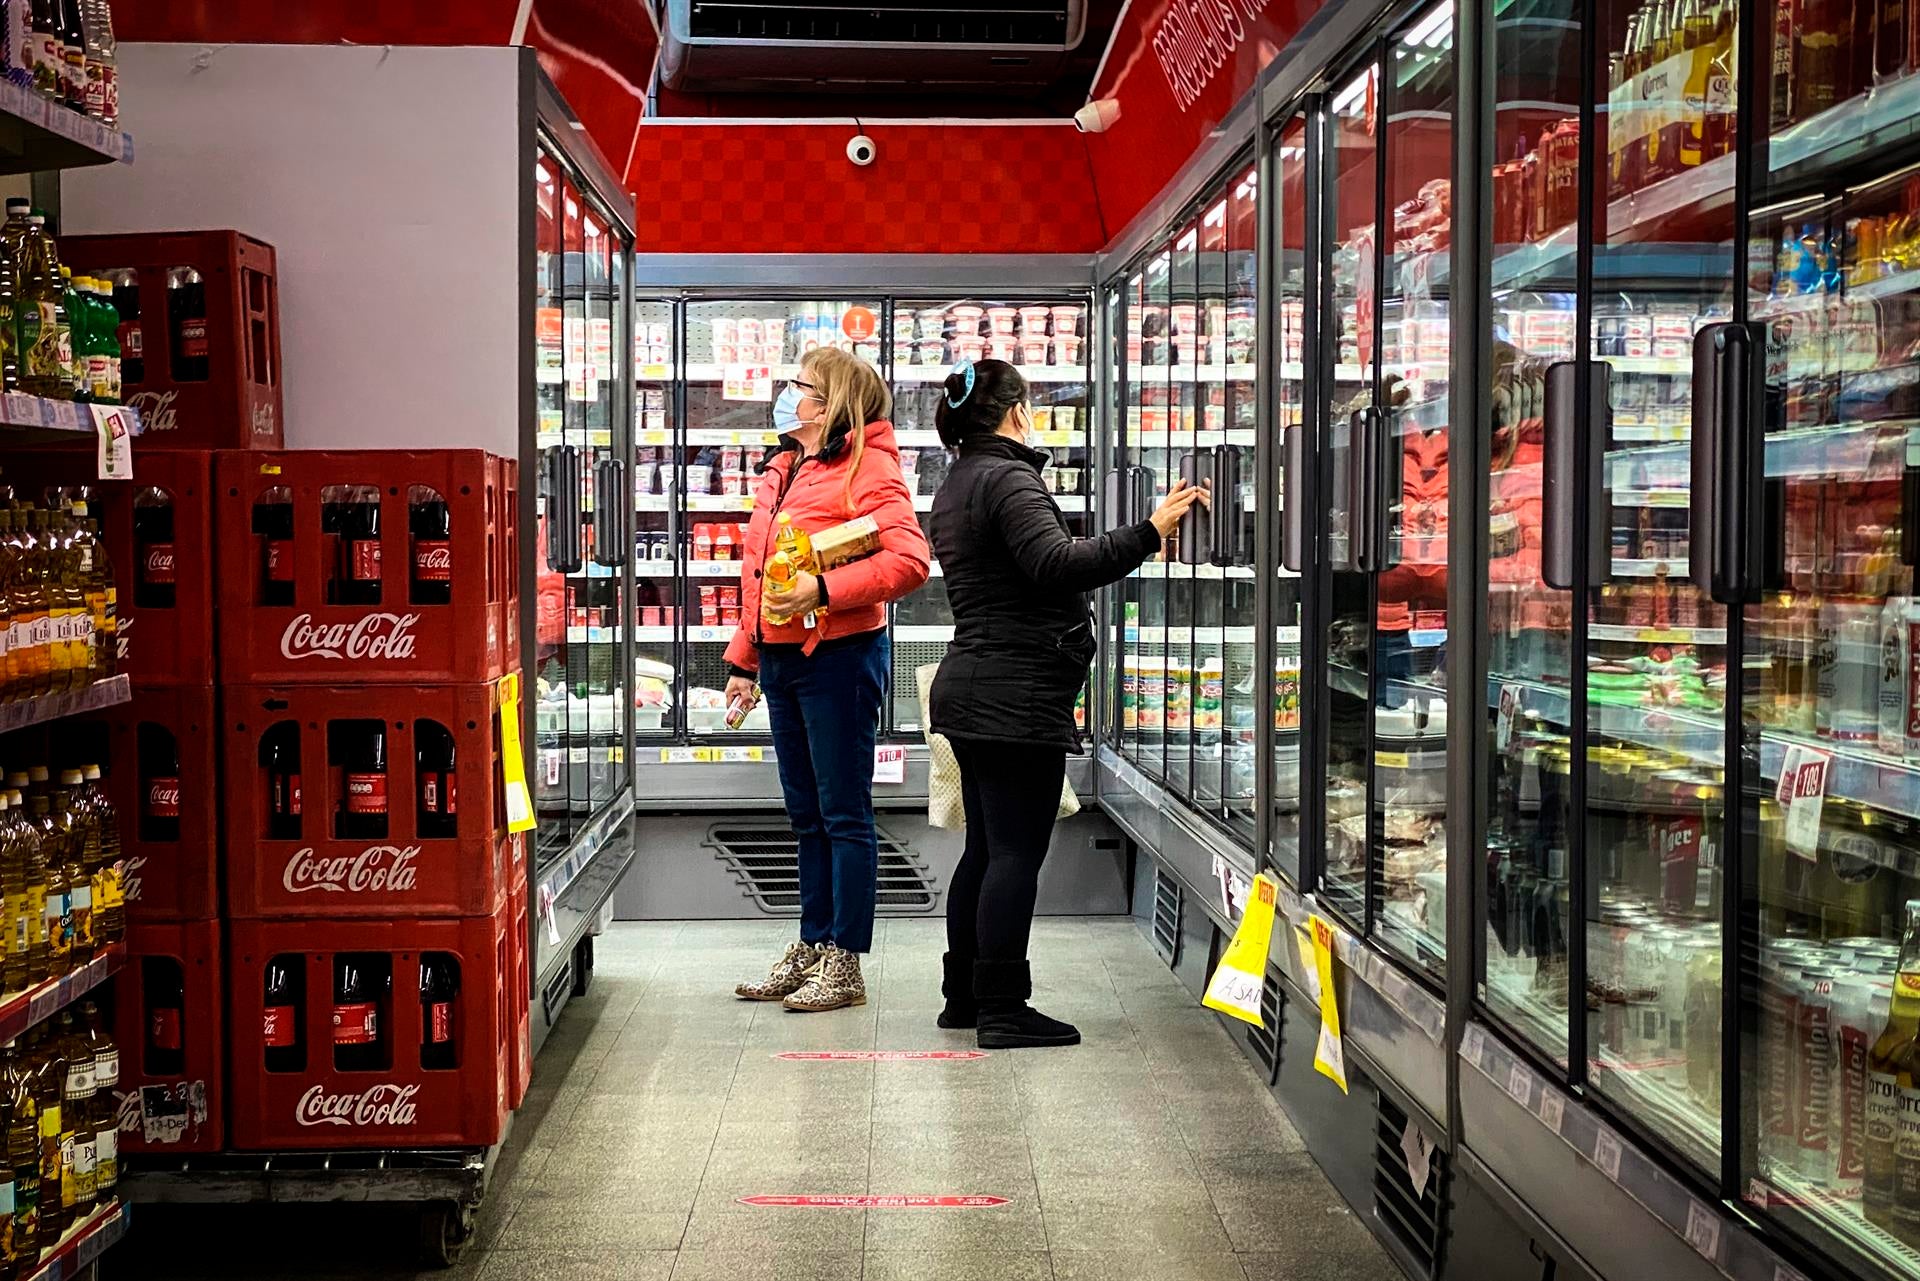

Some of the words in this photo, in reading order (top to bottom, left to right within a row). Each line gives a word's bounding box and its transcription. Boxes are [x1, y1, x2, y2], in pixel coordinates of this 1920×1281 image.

[280, 613, 420, 659] Coca-Cola
[1801, 764, 1820, 796] 109
[283, 845, 421, 893] Coca-Cola
[296, 1084, 421, 1126] Coca-Cola
